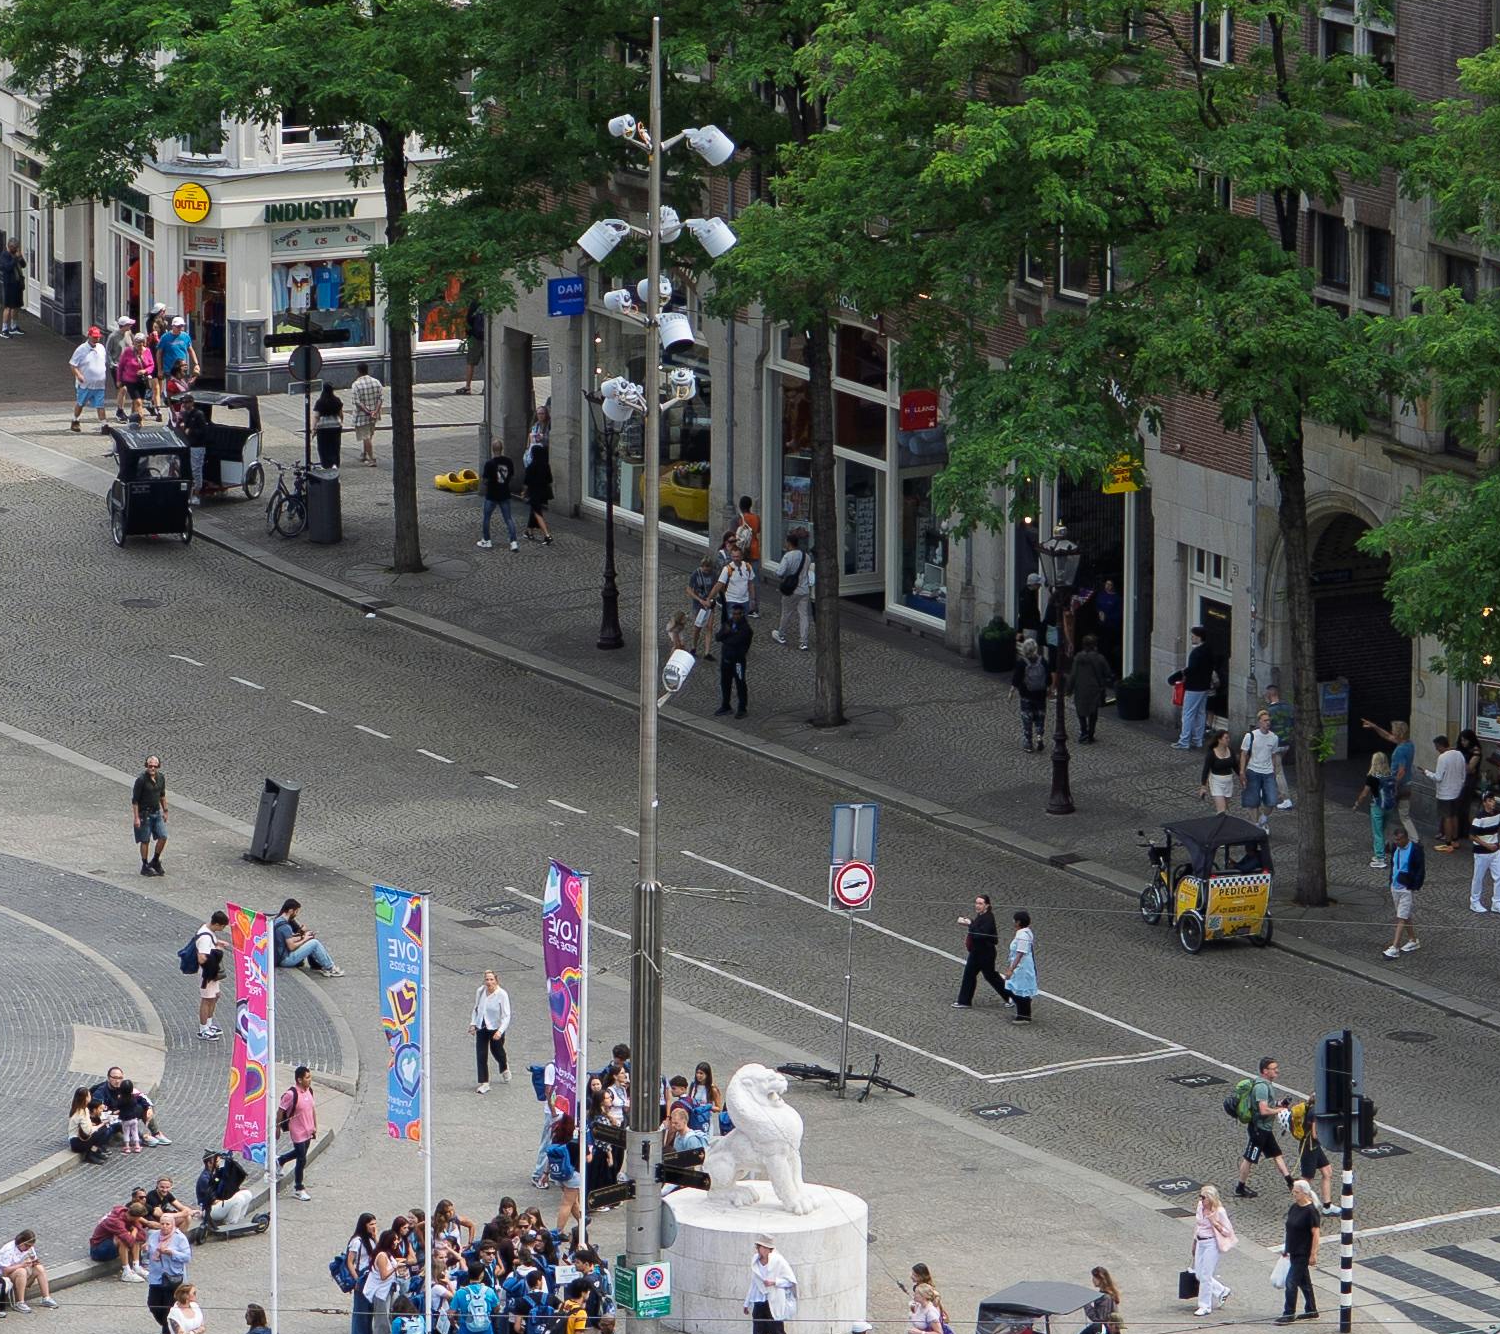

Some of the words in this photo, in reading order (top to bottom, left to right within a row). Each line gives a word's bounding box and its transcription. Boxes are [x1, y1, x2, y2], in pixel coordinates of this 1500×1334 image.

[175, 199, 208, 211] OUTLET
[264, 198, 358, 223] INDUSTRY
[558, 284, 582, 295] DAM
[1219, 885, 1261, 897] PEDICAB
